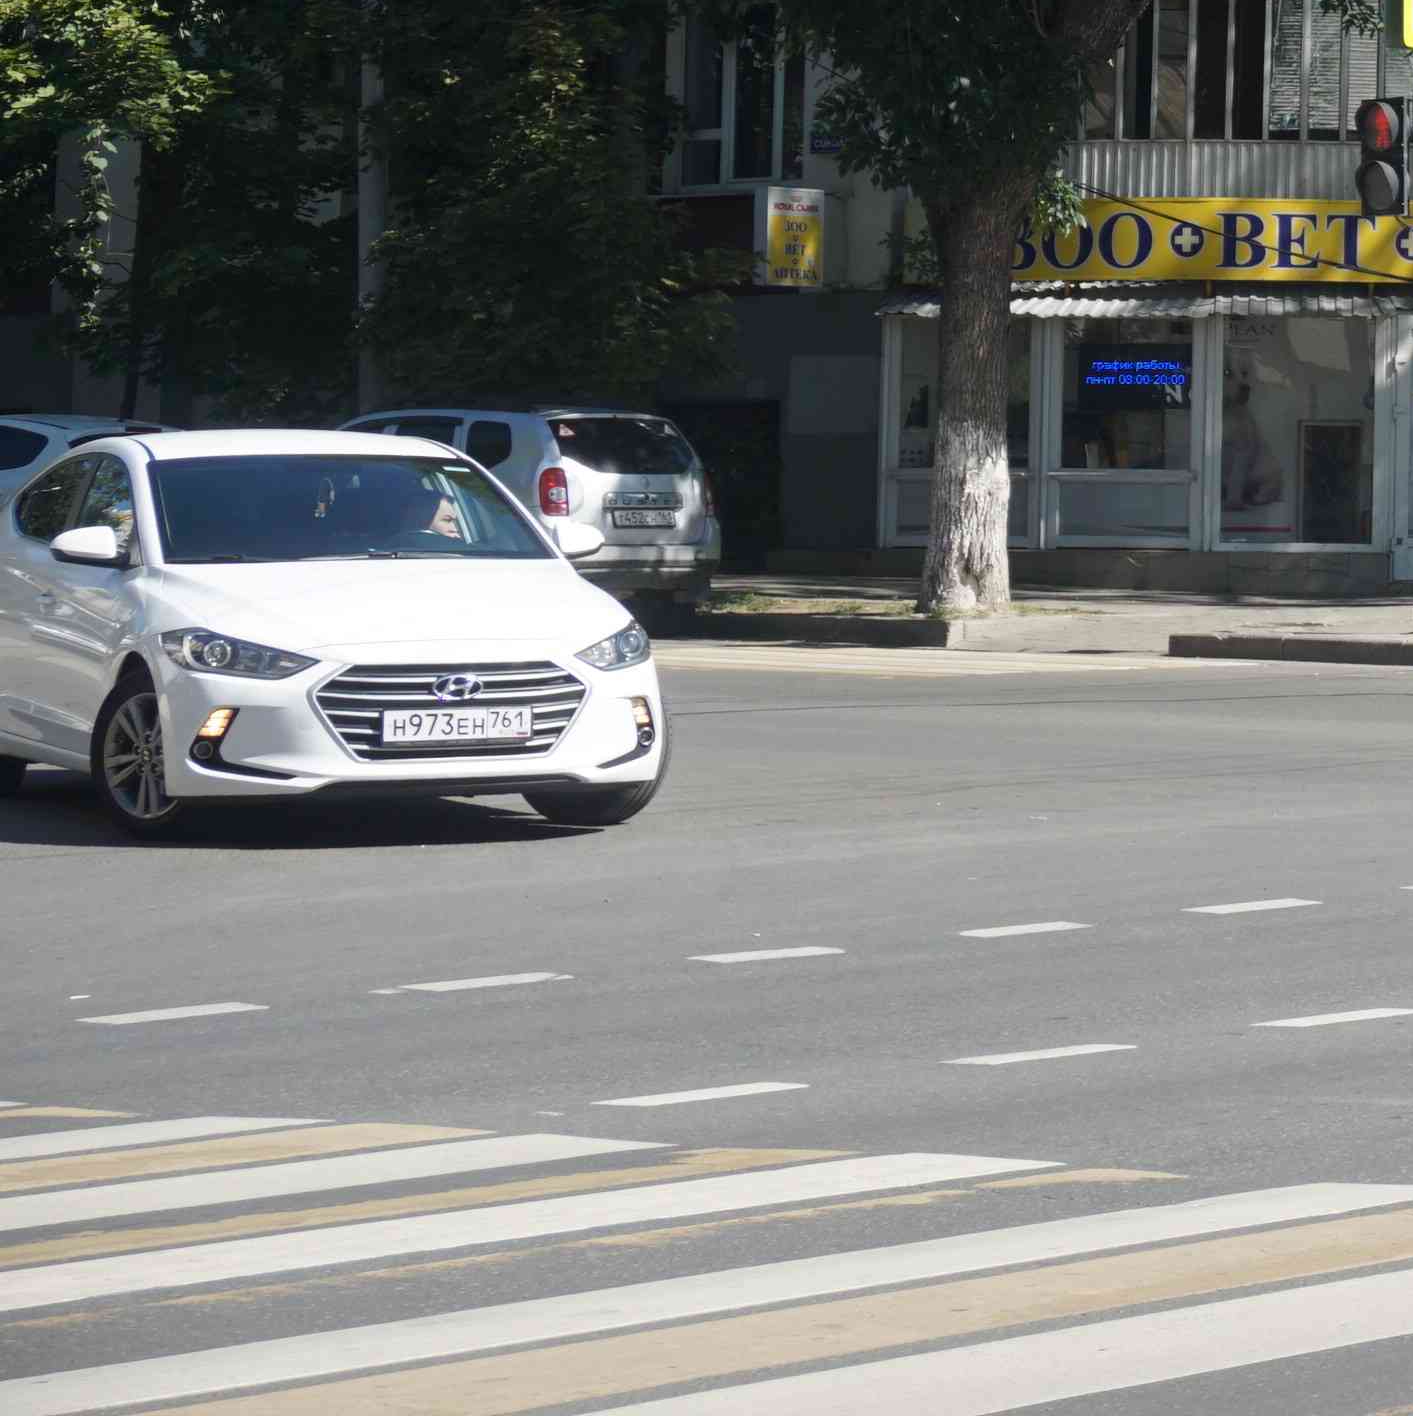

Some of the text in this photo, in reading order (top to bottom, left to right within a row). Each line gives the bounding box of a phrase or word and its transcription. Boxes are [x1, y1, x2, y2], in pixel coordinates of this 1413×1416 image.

[1216, 213, 1377, 269] ВЕТ
[393, 711, 524, 737] Н973ЕН 761
